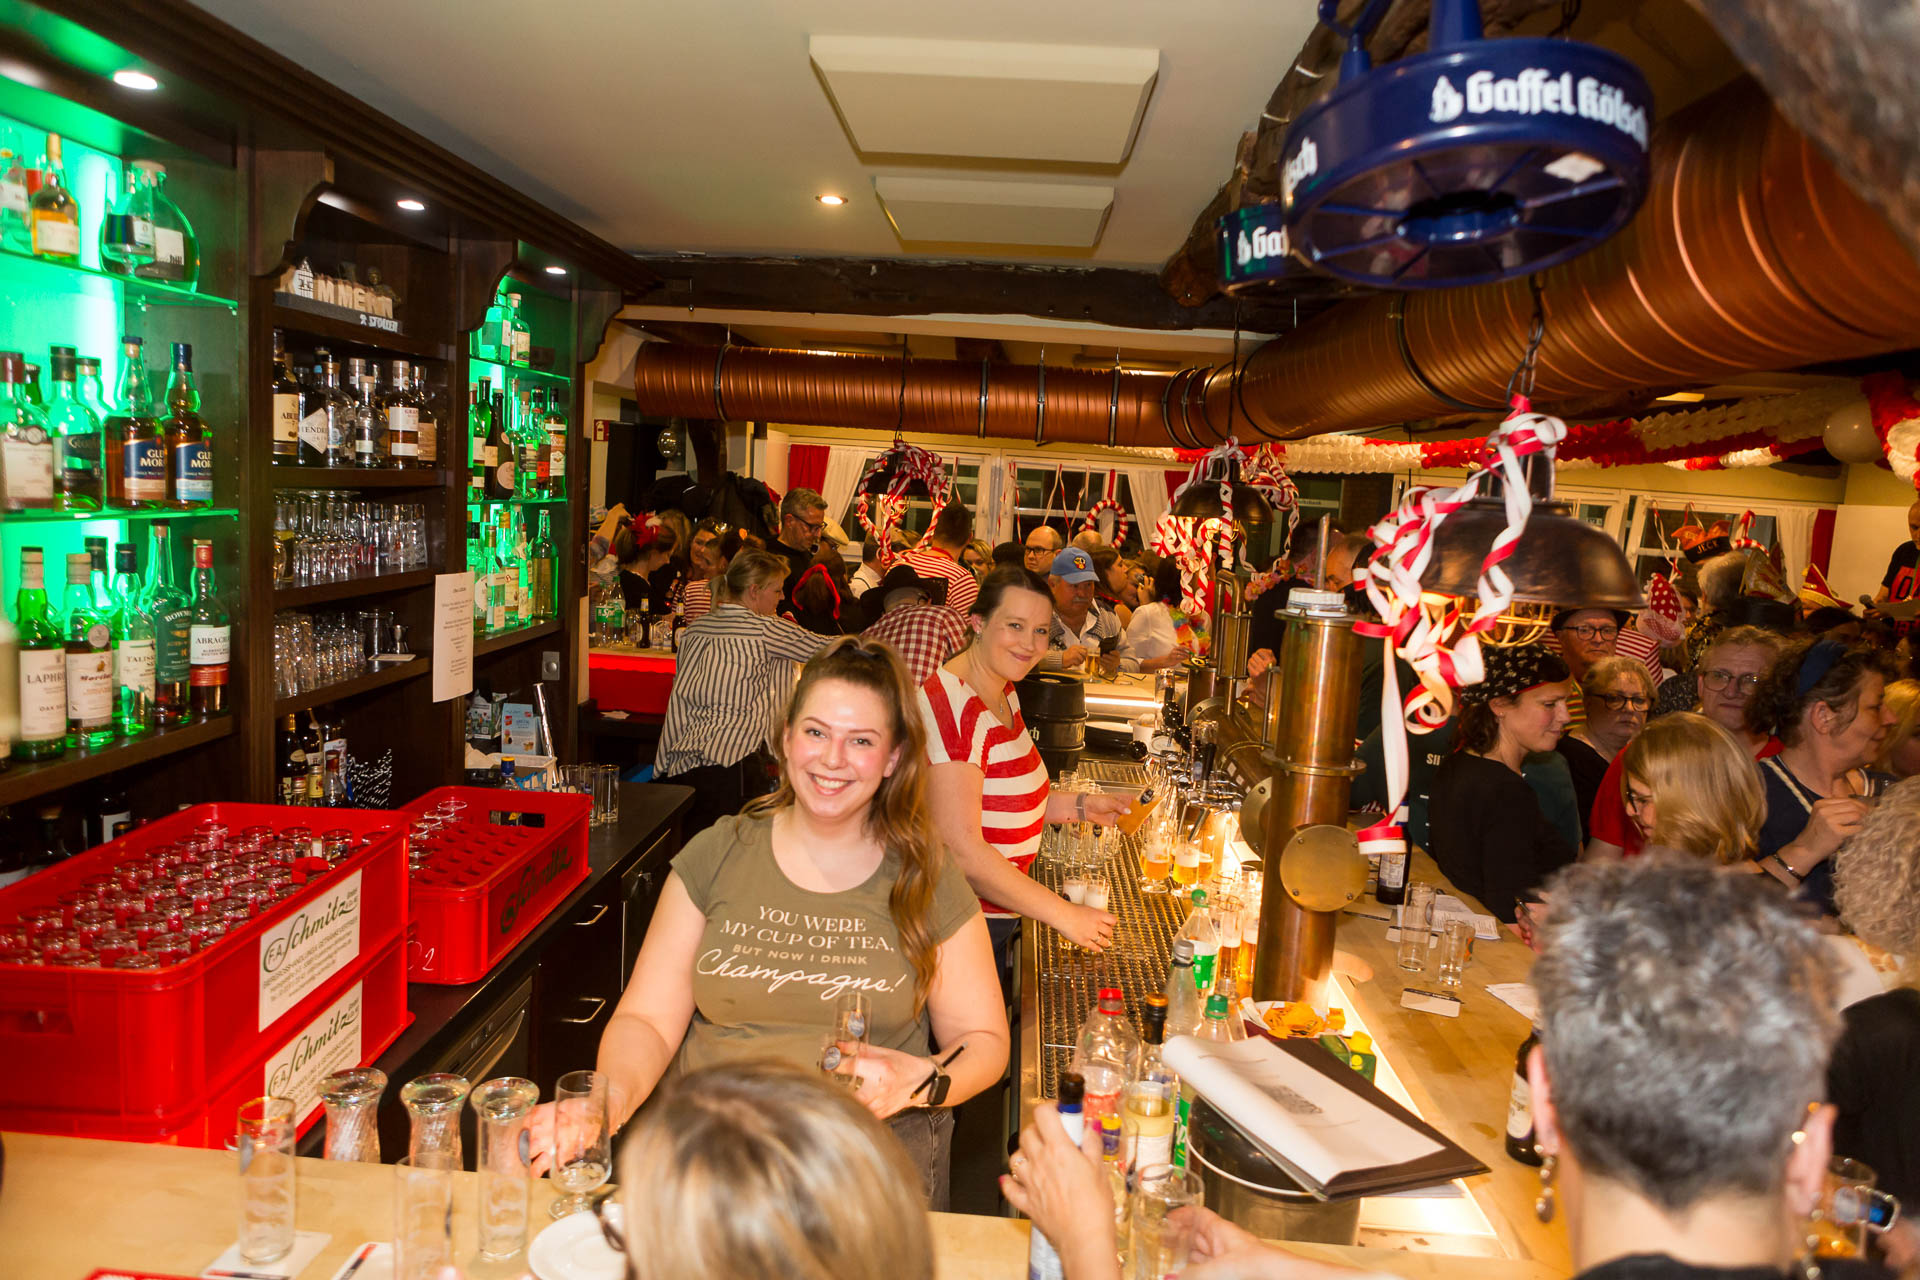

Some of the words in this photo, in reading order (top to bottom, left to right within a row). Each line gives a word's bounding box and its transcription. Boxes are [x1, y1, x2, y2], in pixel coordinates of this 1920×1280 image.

[1466, 68, 1577, 115] Gaffel
[266, 896, 358, 970] Schmitz
[719, 919, 756, 937] MY
[756, 928, 803, 945] CUP
[808, 935, 840, 949] OF
[758, 905, 800, 926] YOU
[803, 914, 867, 933] WERE
[696, 948, 908, 1001] Champagne!
[732, 943, 763, 957] BUT
[767, 950, 804, 961] NOW
[809, 954, 816, 962] I
[820, 954, 868, 965] DRINK
[270, 1010, 360, 1090] Schmitz
